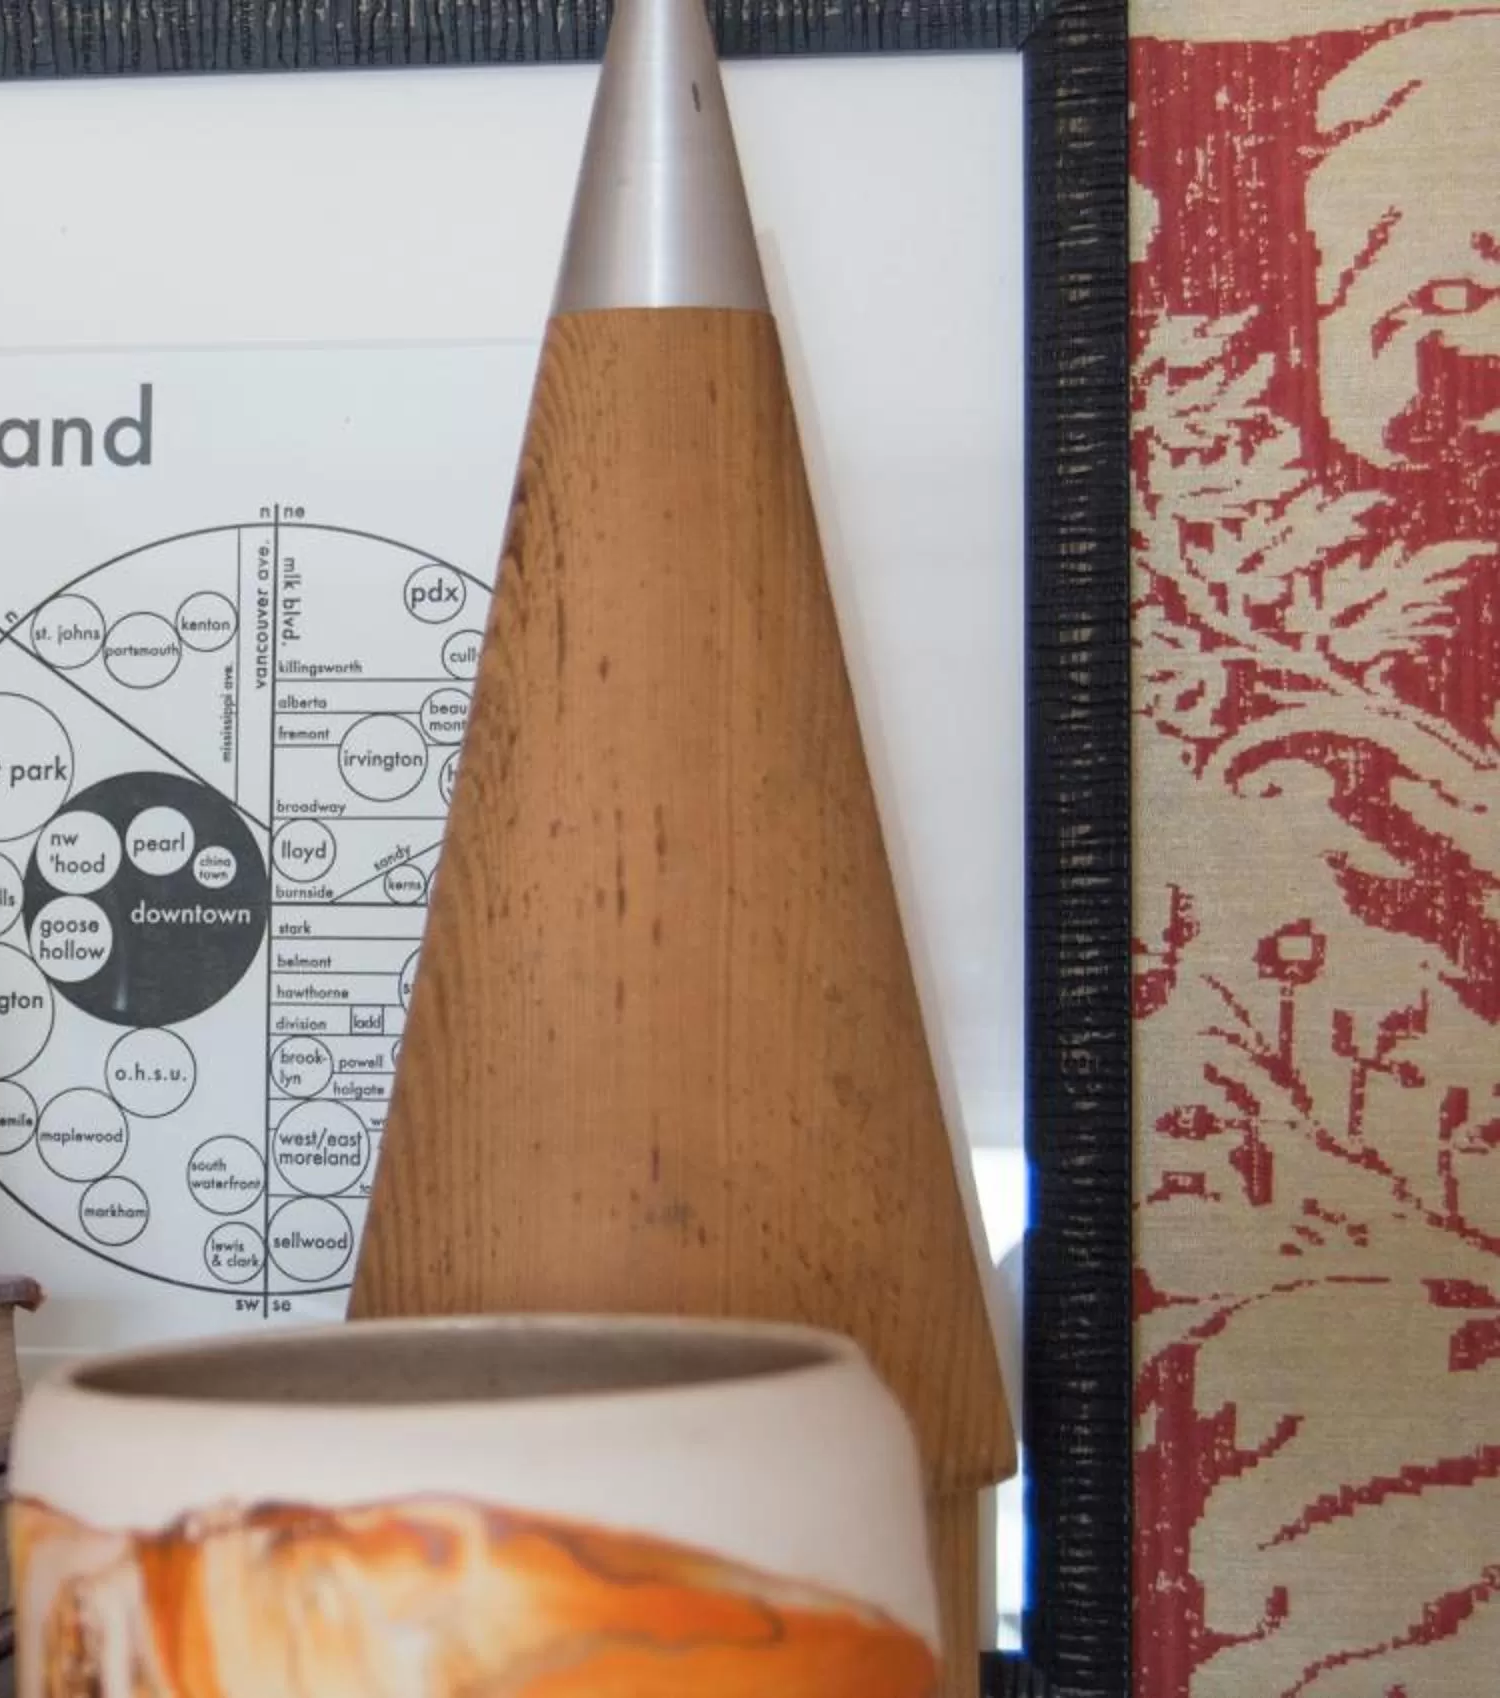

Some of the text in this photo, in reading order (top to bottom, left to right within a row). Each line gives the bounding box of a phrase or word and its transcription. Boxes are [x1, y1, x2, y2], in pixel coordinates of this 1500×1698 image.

[260, 507, 305, 518] n ne
[282, 557, 301, 646] mlk blvd.
[411, 579, 459, 609] pdx
[5, 609, 19, 624] n
[256, 541, 270, 689] vancouver ave.
[182, 617, 230, 631] kenton
[35, 626, 100, 644] st. johns
[105, 643, 179, 658] portsmouth
[279, 661, 362, 677] killingsworth
[279, 697, 326, 709] alberta
[219, 692, 235, 762] mississippi
[279, 727, 329, 740] fremont
[344, 750, 422, 771] irvington
[11, 756, 68, 787] park
[277, 801, 346, 816] broadway
[51, 833, 78, 845] nw
[134, 832, 185, 856] pearl
[282, 841, 327, 863] lloyd
[374, 845, 411, 871] sandy
[50, 855, 105, 873] 'hood
[200, 856, 230, 868] china
[200, 869, 228, 880] town
[276, 886, 333, 898] burnside
[388, 879, 421, 891] kerns
[131, 901, 250, 923] downtown
[41, 920, 99, 937] goose
[279, 922, 311, 934] stark
[40, 941, 104, 960] hollow
[277, 957, 332, 968] belmont
[277, 985, 349, 999] hawthorne
[276, 1018, 327, 1031] division
[353, 1016, 381, 1029] ladd
[339, 1056, 383, 1072] powell
[115, 1064, 187, 1081] o.h.s.u.
[280, 1072, 301, 1086] lyn
[333, 1083, 384, 1099] holgate
[40, 1127, 122, 1146] maplewood
[279, 1128, 362, 1151] west/east
[279, 1148, 361, 1166] moreland
[192, 1159, 226, 1172] south
[191, 1176, 261, 1190] waterfront
[84, 1205, 146, 1218] markham
[212, 1239, 244, 1252] lewis
[273, 1230, 348, 1250] sellwood
[212, 1254, 258, 1267] & clark
[235, 1300, 292, 1312] sw se
